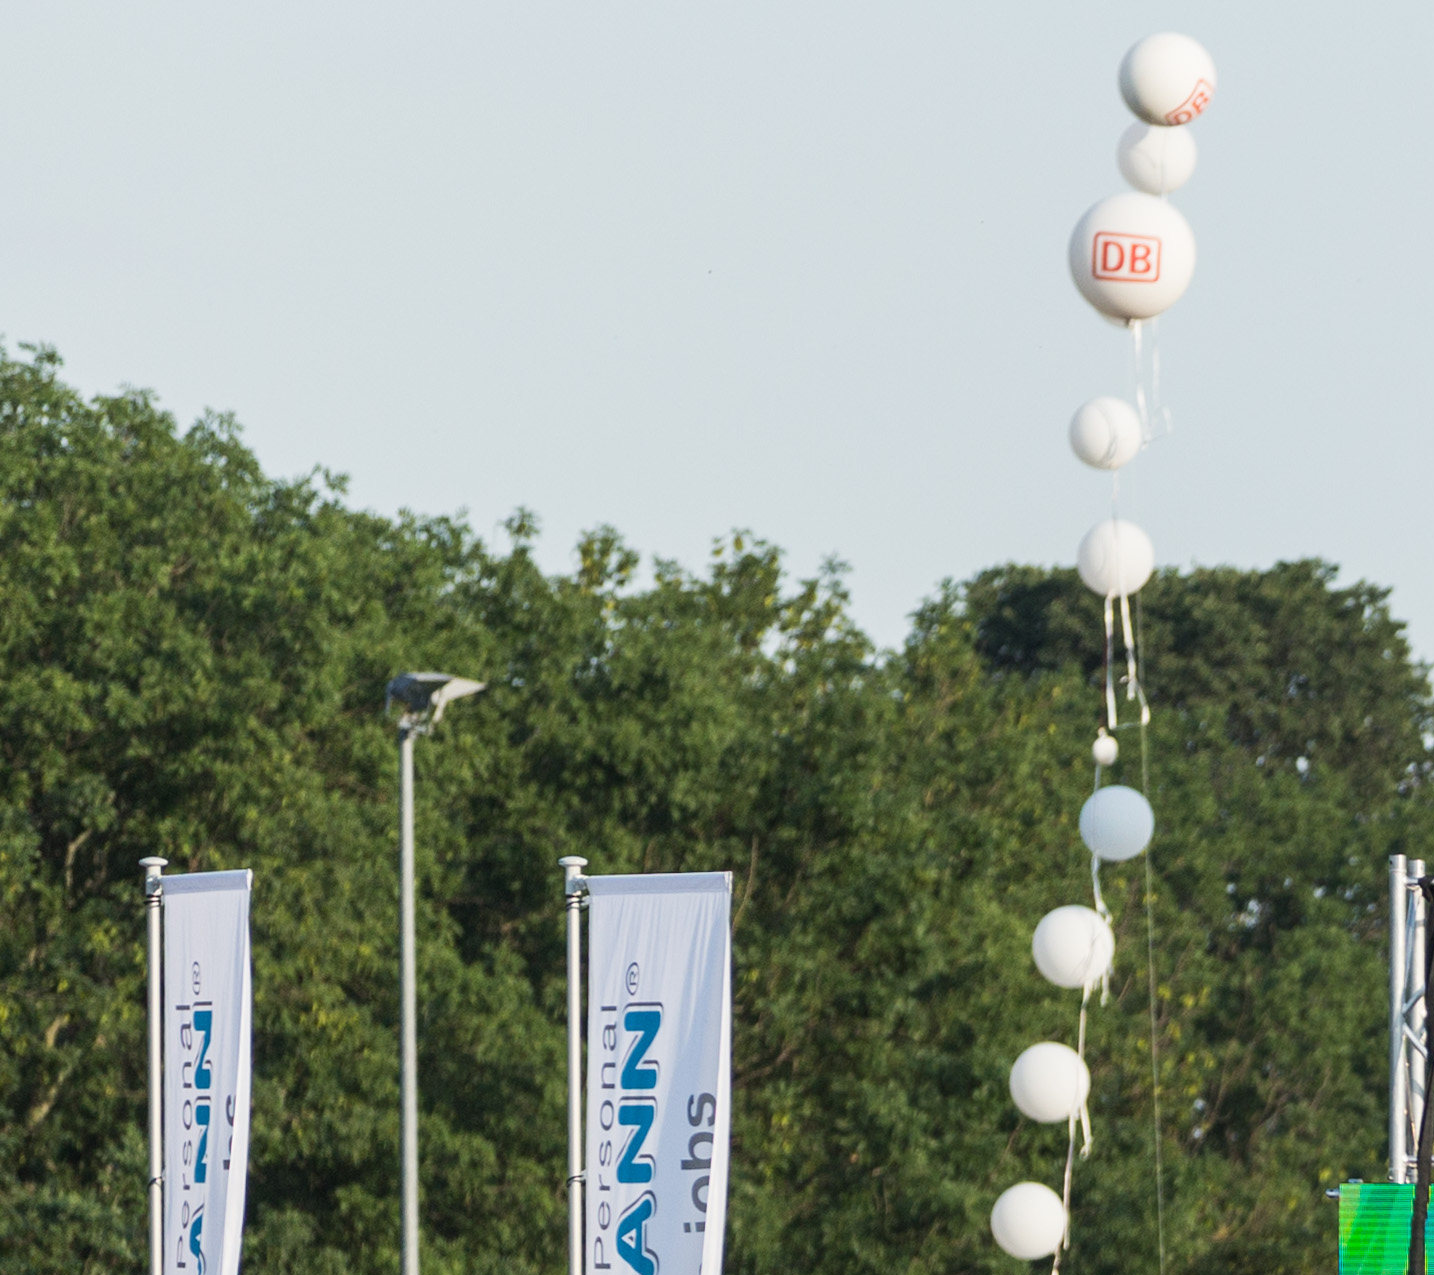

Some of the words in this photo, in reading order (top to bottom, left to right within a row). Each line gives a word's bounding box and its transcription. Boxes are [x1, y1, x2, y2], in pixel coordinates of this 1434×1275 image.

[1101, 240, 1152, 274] DB
[176, 1004, 193, 1269] Personal
[593, 1004, 618, 1270] Personal
